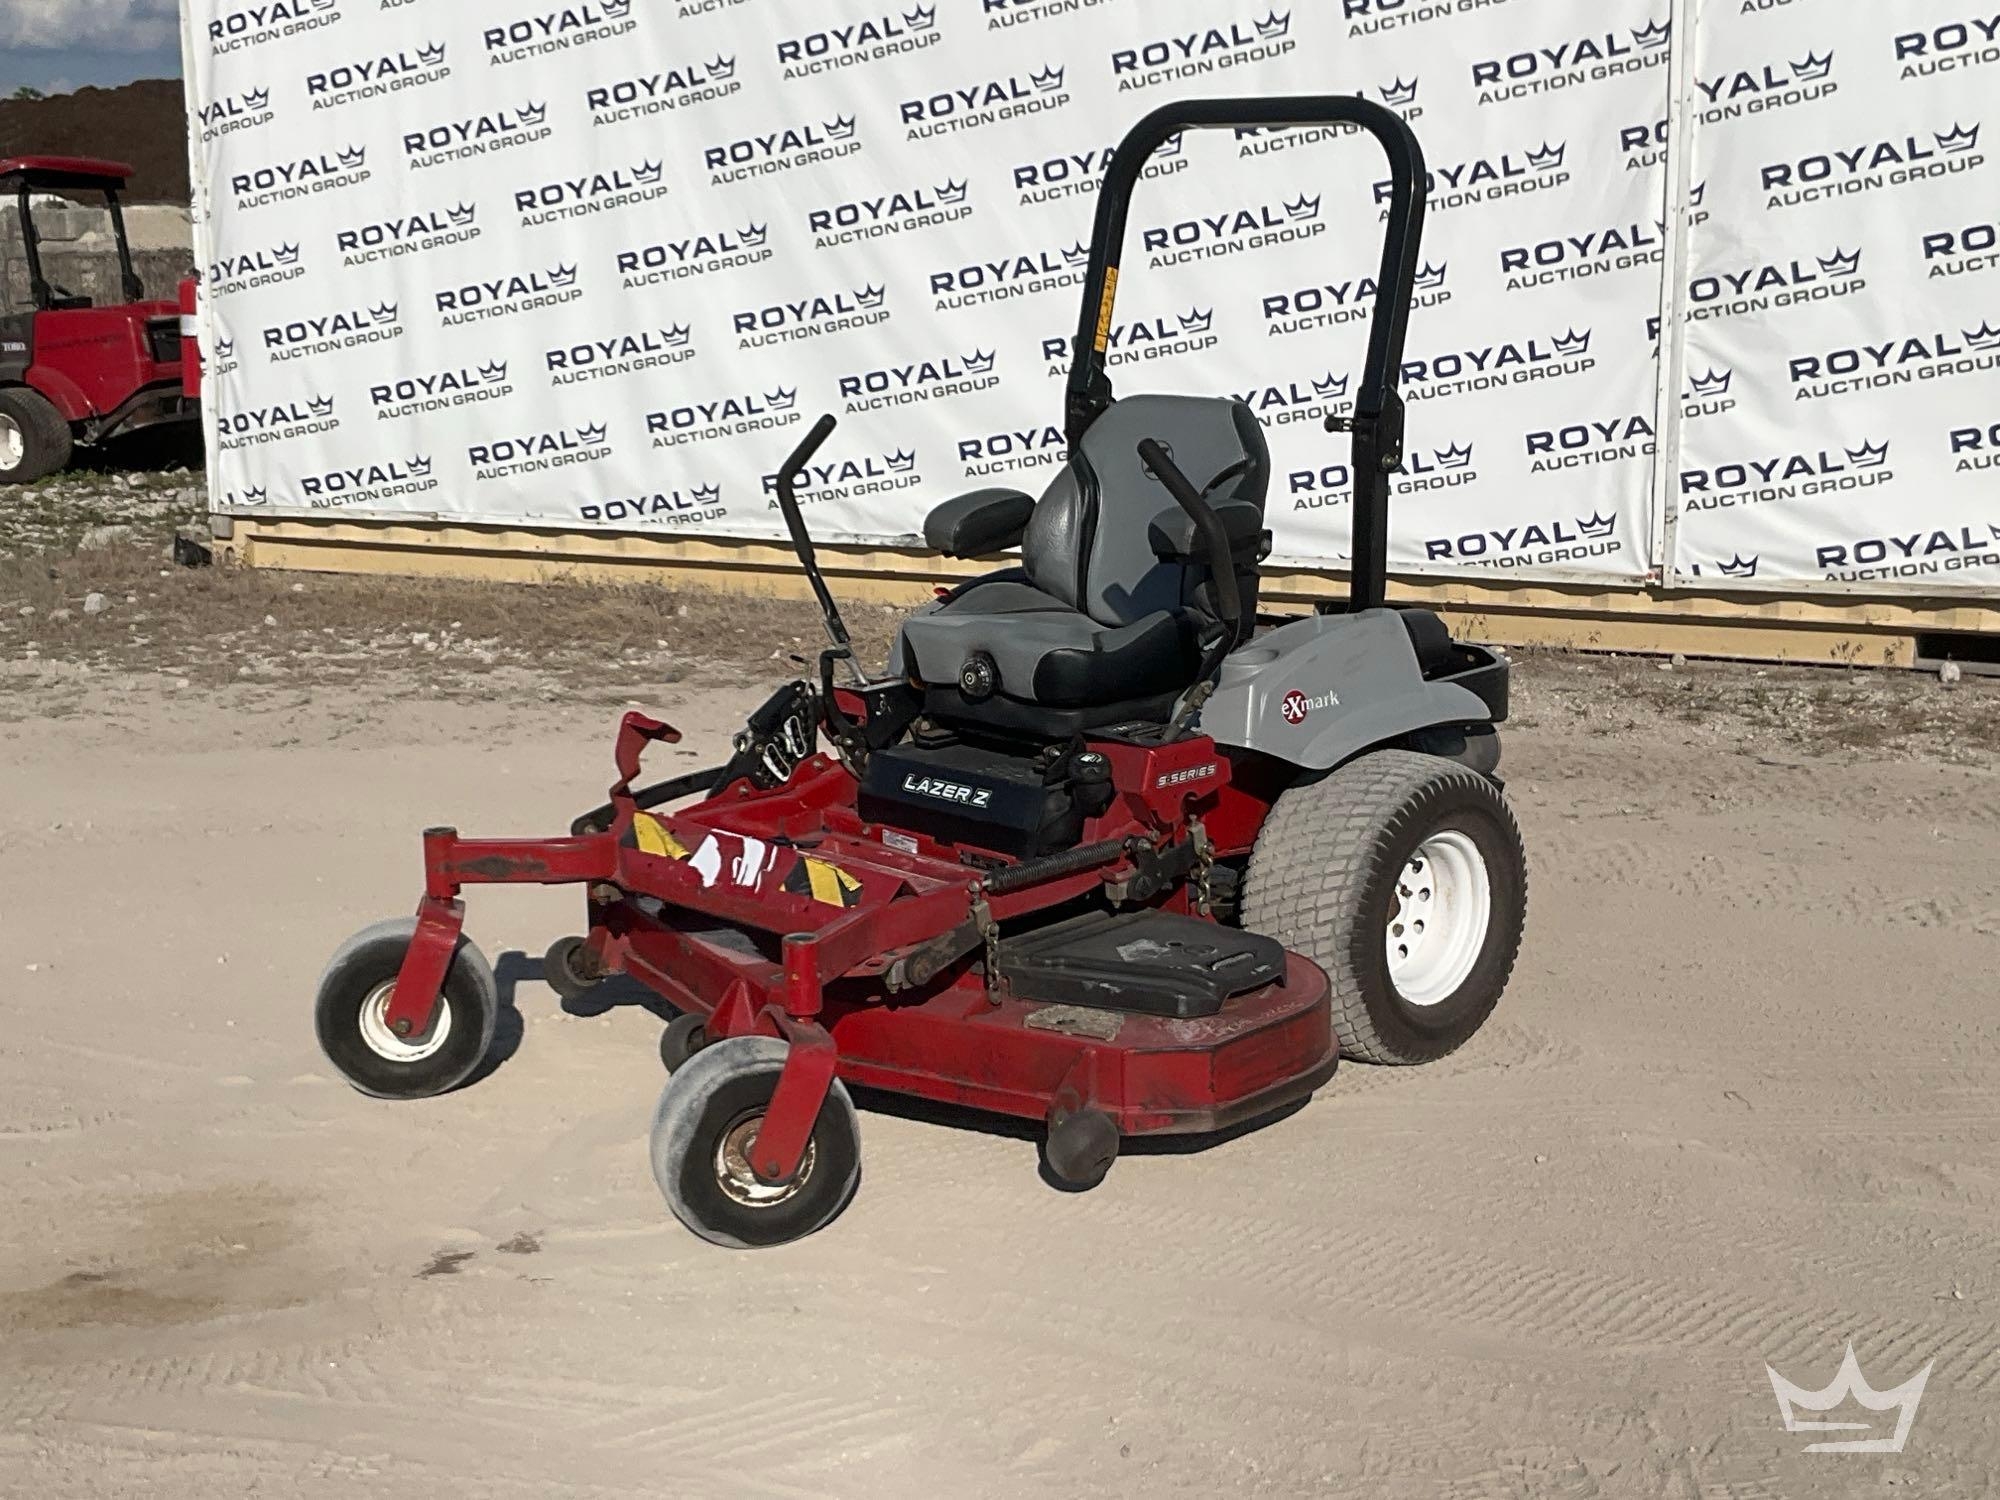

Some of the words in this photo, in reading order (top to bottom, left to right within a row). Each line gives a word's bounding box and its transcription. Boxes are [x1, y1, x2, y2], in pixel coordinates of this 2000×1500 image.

[208, 0, 310, 42] ROYAL
[211, 28, 280, 56] AUCTION
[283, 12, 341, 36] GROUP
[484, 5, 602, 50] ROYAL
[988, 0, 1078, 31] AUCTION
[1349, 3, 1452, 38] AUCTION
[491, 37, 569, 66] AUCTION
[573, 20, 636, 45] GROUP
[777, 16, 904, 64] ROYAL
[784, 50, 869, 80] AUCTION
[872, 32, 941, 59] GROUP
[1112, 24, 1254, 75] ROYAL
[1894, 14, 2000, 61] ROY
[307, 53, 418, 95] ROYAL
[1119, 59, 1213, 92] AUCTION
[1218, 40, 1295, 68] GROUP
[1472, 33, 1631, 87] ROYAL
[1901, 48, 2000, 80] AUCTIO
[313, 83, 387, 110] AUCTION
[390, 67, 450, 91] GROUP
[587, 66, 706, 111] ROYAL
[593, 98, 675, 126] AUCTION
[678, 82, 741, 106] GROUP
[900, 77, 1031, 124] ROYAL
[1478, 70, 1585, 105] AUCTION
[1696, 65, 1789, 103] YAL
[1747, 82, 1838, 114] GROUP
[198, 98, 243, 126] YAL
[220, 111, 274, 135] GROUP
[907, 111, 995, 141] AUCTION
[999, 94, 1070, 120] GROUP
[403, 112, 518, 154] ROYAL
[411, 143, 486, 169] AUCTION
[489, 127, 551, 151] GROUP
[704, 126, 824, 170] ROYAL
[1239, 125, 1338, 159] AUCTION
[232, 155, 339, 195] ROYAL
[711, 157, 791, 186] AUCTION
[794, 142, 861, 166] GROUP
[1013, 147, 1116, 189] ROYA
[1761, 137, 1934, 191] ROYAL
[1767, 173, 1883, 210] AUCTION
[1890, 154, 1984, 187] GROUP
[238, 185, 309, 210] AUCTION
[312, 170, 371, 192] GROUP
[515, 170, 632, 212] ROYAL
[1487, 172, 1569, 200] GROUP
[522, 201, 601, 227] AUCTION
[604, 186, 667, 209] GROUP
[809, 189, 935, 233] ROYAL
[337, 212, 448, 252] ROYAL
[344, 242, 418, 266] AUCTION
[421, 228, 481, 250] GROUP
[816, 222, 899, 249] AUCTION
[903, 206, 972, 230] GROUP
[1143, 206, 1284, 252] ROYAL
[1149, 239, 1244, 269] AUCTION
[1249, 223, 1326, 249] GROUP
[617, 233, 739, 274] ROYAL
[1501, 224, 1655, 273] ROYAL
[250, 267, 305, 288] GROUP
[623, 263, 704, 289] AUCTION
[707, 249, 773, 272] GROUP
[930, 252, 1062, 295] ROYAL
[1506, 260, 1610, 291] AUCTION
[1689, 261, 1817, 302] OYAL
[435, 273, 549, 312] ROYAL
[442, 302, 518, 327] AUCTION
[521, 289, 582, 311] GROUP
[936, 284, 1024, 311] AUCTION
[1028, 271, 1086, 293] GROU
[1262, 277, 1378, 319] ROYA
[1774, 279, 1866, 307] GROUP
[263, 311, 371, 348] ROYAL
[733, 294, 855, 334] ROYAL
[739, 324, 821, 350] AUCTION
[824, 311, 890, 333] GROUP
[1269, 307, 1367, 336] AUCTION
[270, 339, 341, 362] AUCTION
[344, 326, 403, 347] GROUP
[546, 332, 662, 371] ROYAL
[1144, 335, 1218, 360] GROUP
[1400, 340, 1550, 384] ROYAL
[1789, 334, 1962, 382] ROYAL
[370, 369, 480, 405] ROYAL
[552, 362, 630, 386] AUCTION
[633, 349, 695, 370] GROUP
[839, 359, 963, 398] ROYAL
[1406, 373, 1507, 402] AUCTION
[1513, 358, 1595, 383] GROUP
[1795, 369, 1911, 401] AUCTION
[377, 397, 450, 420] AUCTION
[452, 384, 513, 410] GROUP
[646, 396, 765, 433] ROYAL
[846, 389, 928, 414] AUCTION
[932, 376, 999, 398] GROUP
[1276, 401, 1353, 424] GROUP
[219, 430, 281, 450] AUCTION
[284, 419, 340, 439] GROUP
[468, 431, 579, 466] ROYAL
[653, 425, 732, 448] AUCTION
[735, 413, 801, 433] GROUP
[958, 426, 1065, 461] ROYA
[1526, 415, 1654, 455] ROYA
[476, 461, 549, 481] AUCTION
[552, 446, 612, 468] GROUP
[964, 453, 1053, 477] AUCTION
[1530, 445, 1636, 473] AUCTION
[1680, 451, 1845, 494] ROYAL
[300, 463, 408, 496] ROYAL
[310, 489, 379, 509] AUCTION
[382, 478, 438, 498] GROUP
[854, 475, 921, 497] GROUP
[1397, 471, 1477, 495] GROUP
[1685, 485, 1796, 513] AUCTION
[1802, 471, 1893, 496] GROUP
[1425, 522, 1577, 561] ROYAL
[1538, 541, 1622, 564] GROUP
[1816, 527, 1988, 568] ROYAL
[1944, 554, 2000, 571] GRO
[903, 776, 972, 802] LAZER
[972, 790, 989, 805] Z
